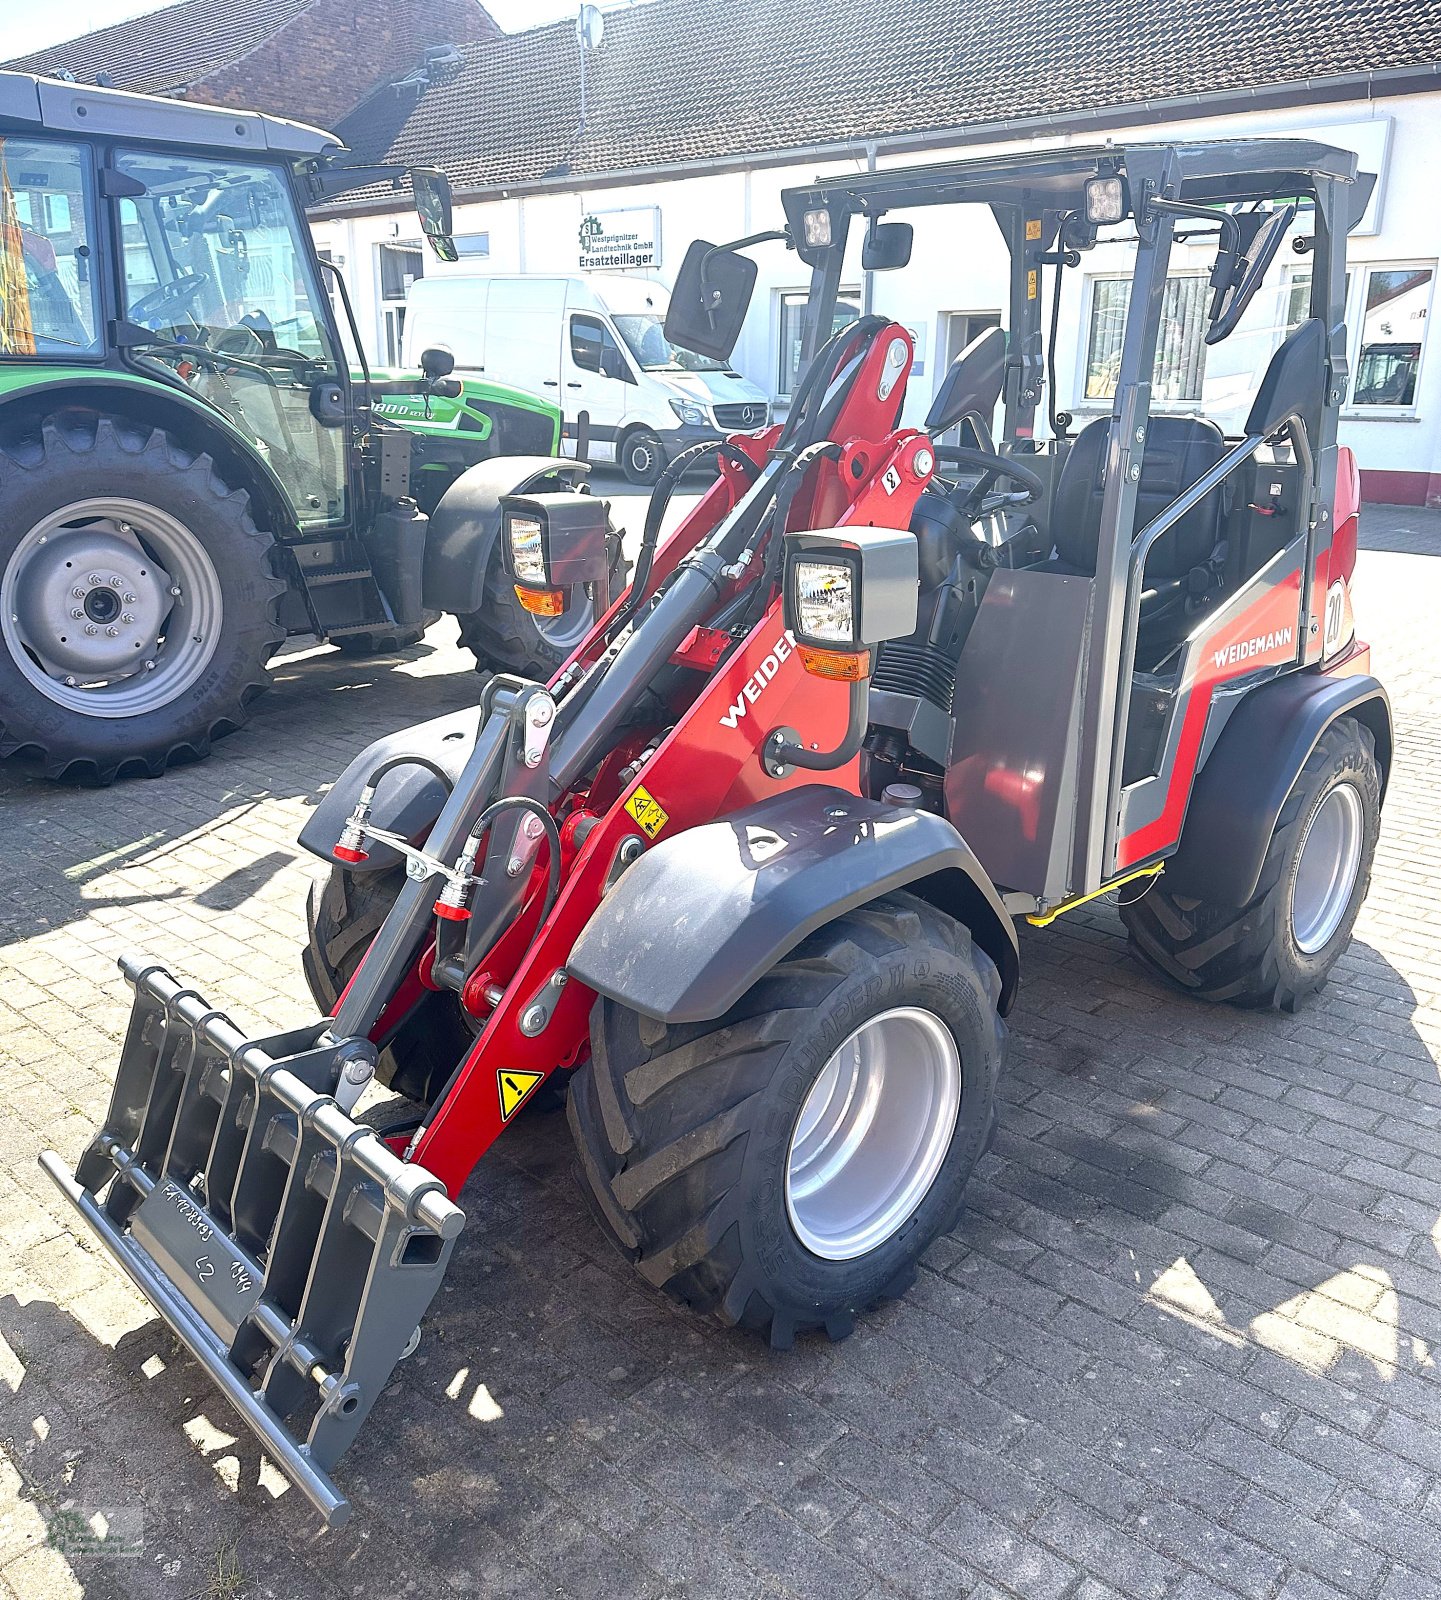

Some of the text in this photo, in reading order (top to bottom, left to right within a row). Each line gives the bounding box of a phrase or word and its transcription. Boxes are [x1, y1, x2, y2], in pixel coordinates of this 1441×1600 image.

[591, 234, 638, 243] Westprignitzer
[591, 242, 653, 253] Landtechnik GmbH
[579, 253, 653, 267] Ersatzteillager
[1326, 593, 1341, 643] 20
[1214, 626, 1293, 668] WEIDEMANN
[778, 972, 884, 1104] DUMPER
